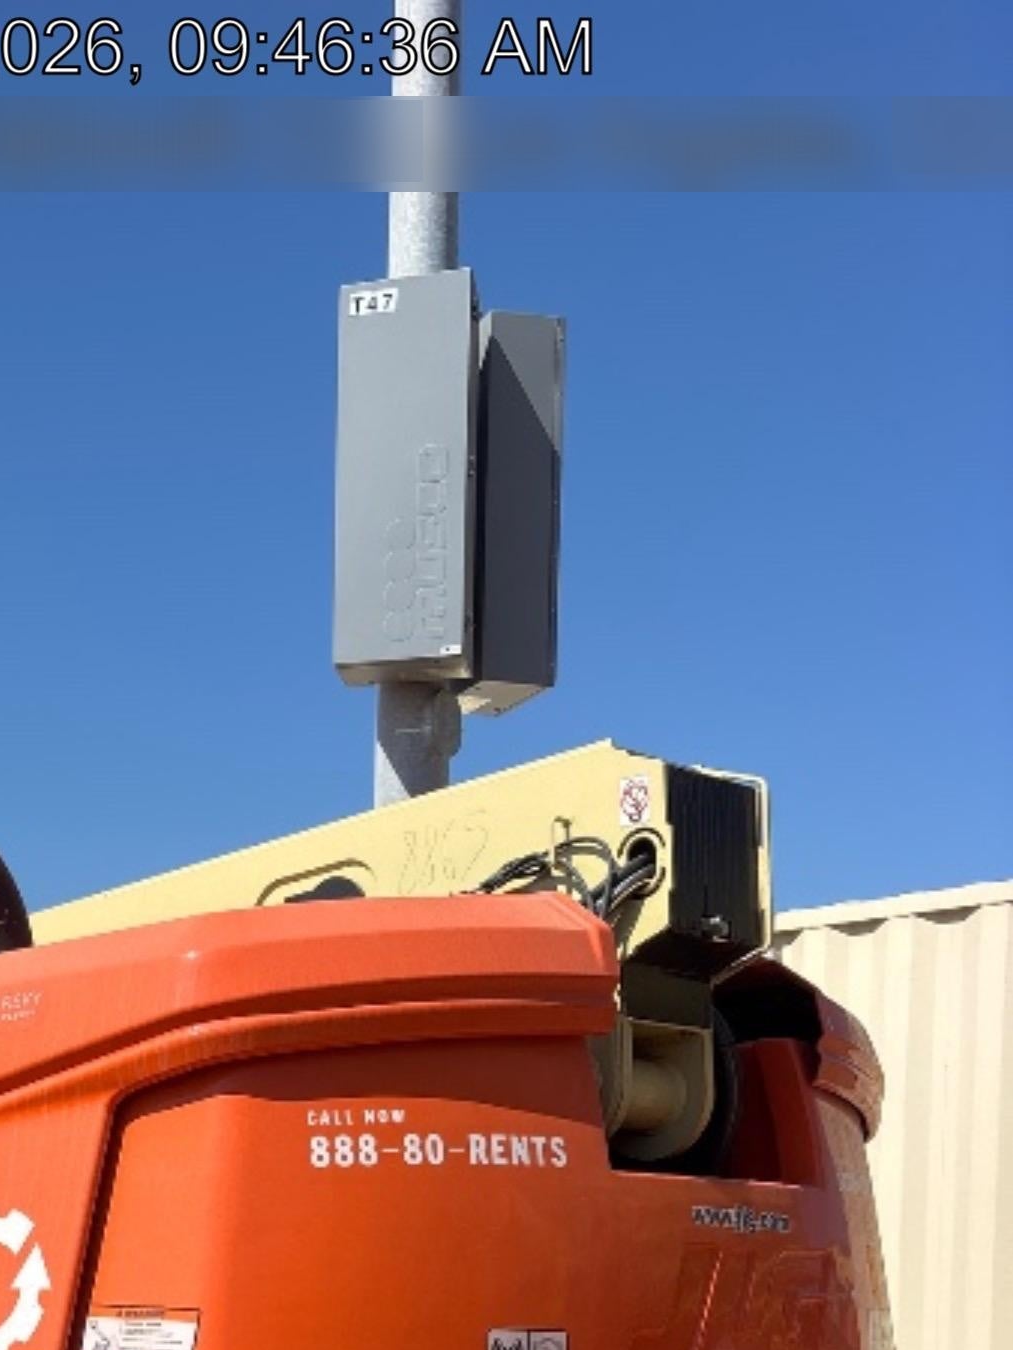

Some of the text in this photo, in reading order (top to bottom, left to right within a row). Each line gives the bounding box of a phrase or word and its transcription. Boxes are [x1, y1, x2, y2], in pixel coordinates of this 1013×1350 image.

[352, 293, 393, 313] T47
[307, 1109, 406, 1126] CALL NOW
[310, 1133, 568, 1168] 888-80-RENTS
